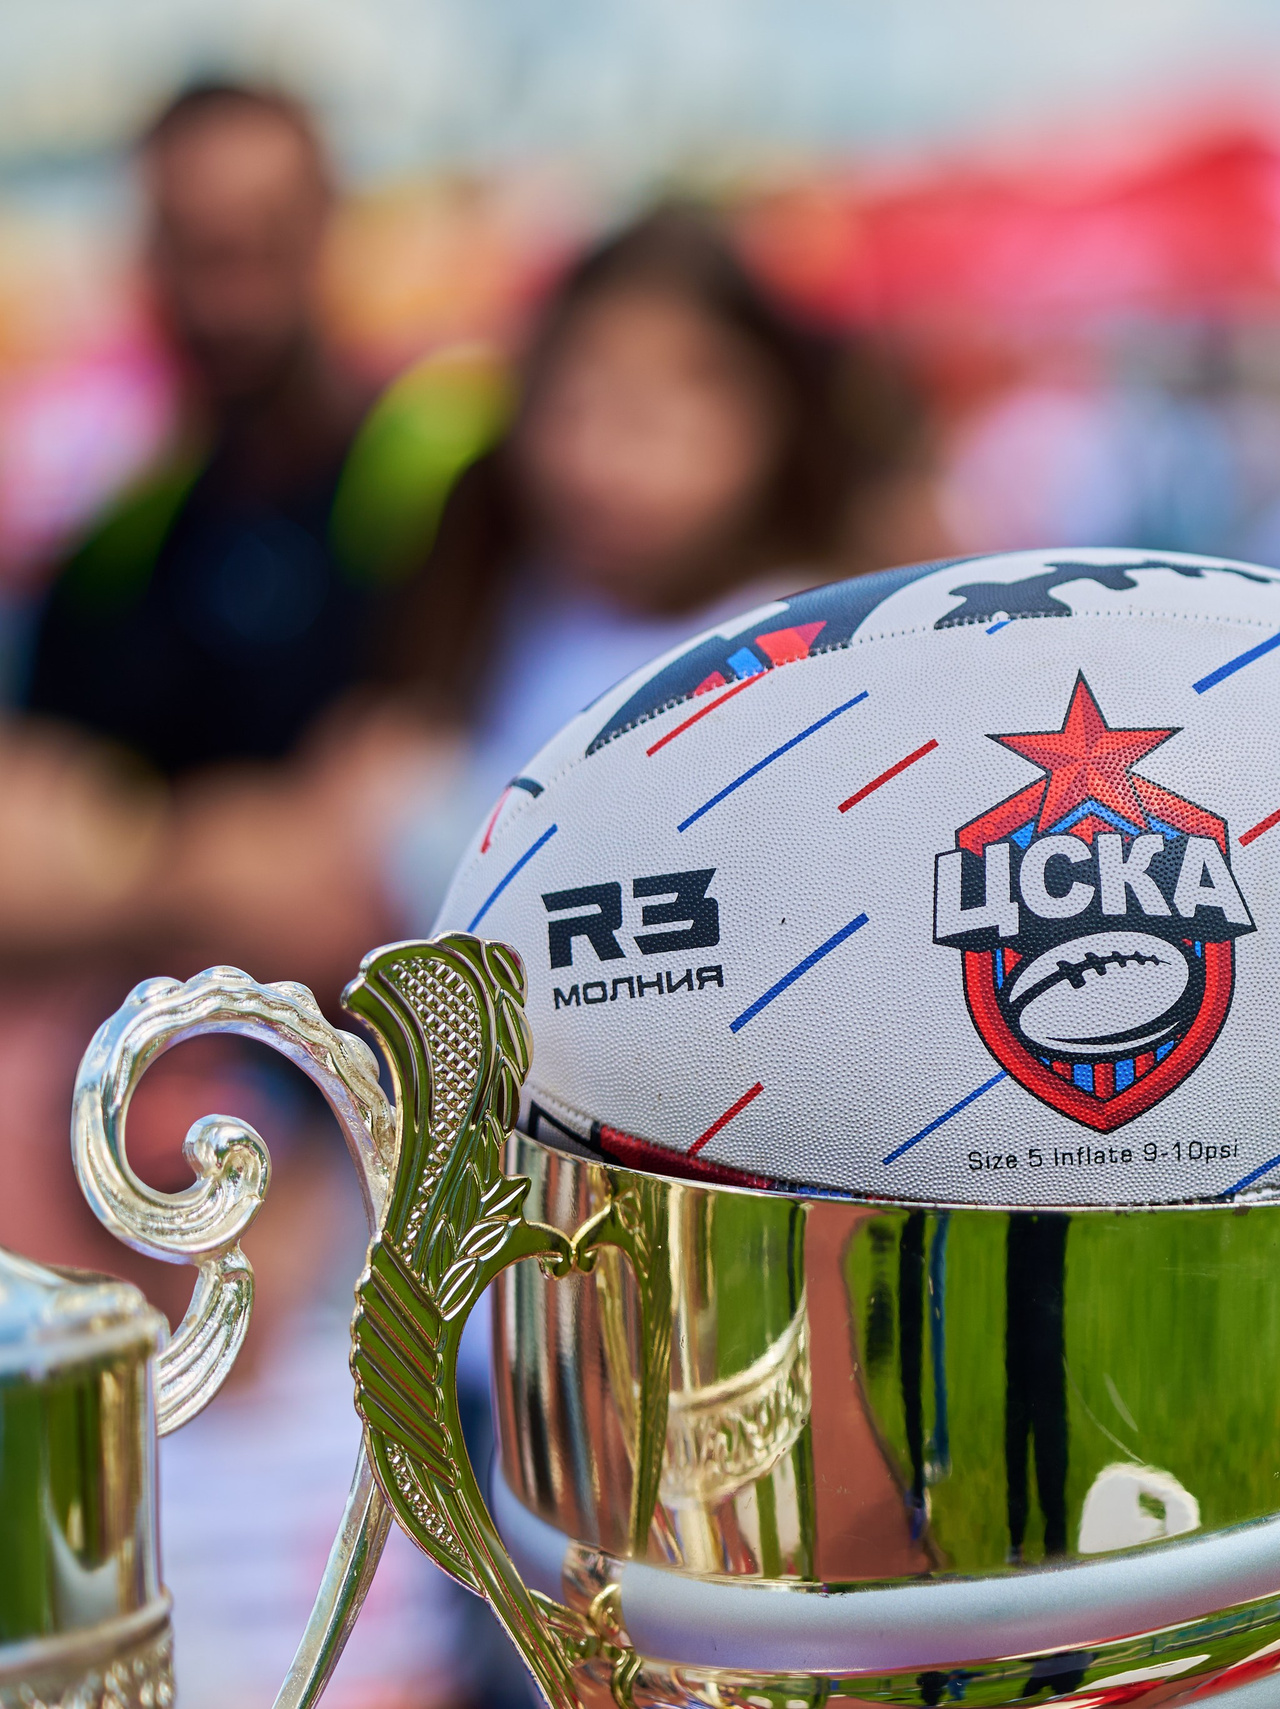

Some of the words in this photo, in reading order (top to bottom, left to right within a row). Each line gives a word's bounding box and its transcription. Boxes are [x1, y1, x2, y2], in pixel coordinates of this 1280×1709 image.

[541, 868, 720, 969] R3
[934, 832, 1254, 939] ЦСКА
[553, 965, 724, 1009] МОЛНИЯ
[968, 1150, 1018, 1171] Size
[1028, 1148, 1043, 1168] 5
[1054, 1146, 1133, 1166] Inflate
[1143, 1139, 1239, 1163] 9-10psi
